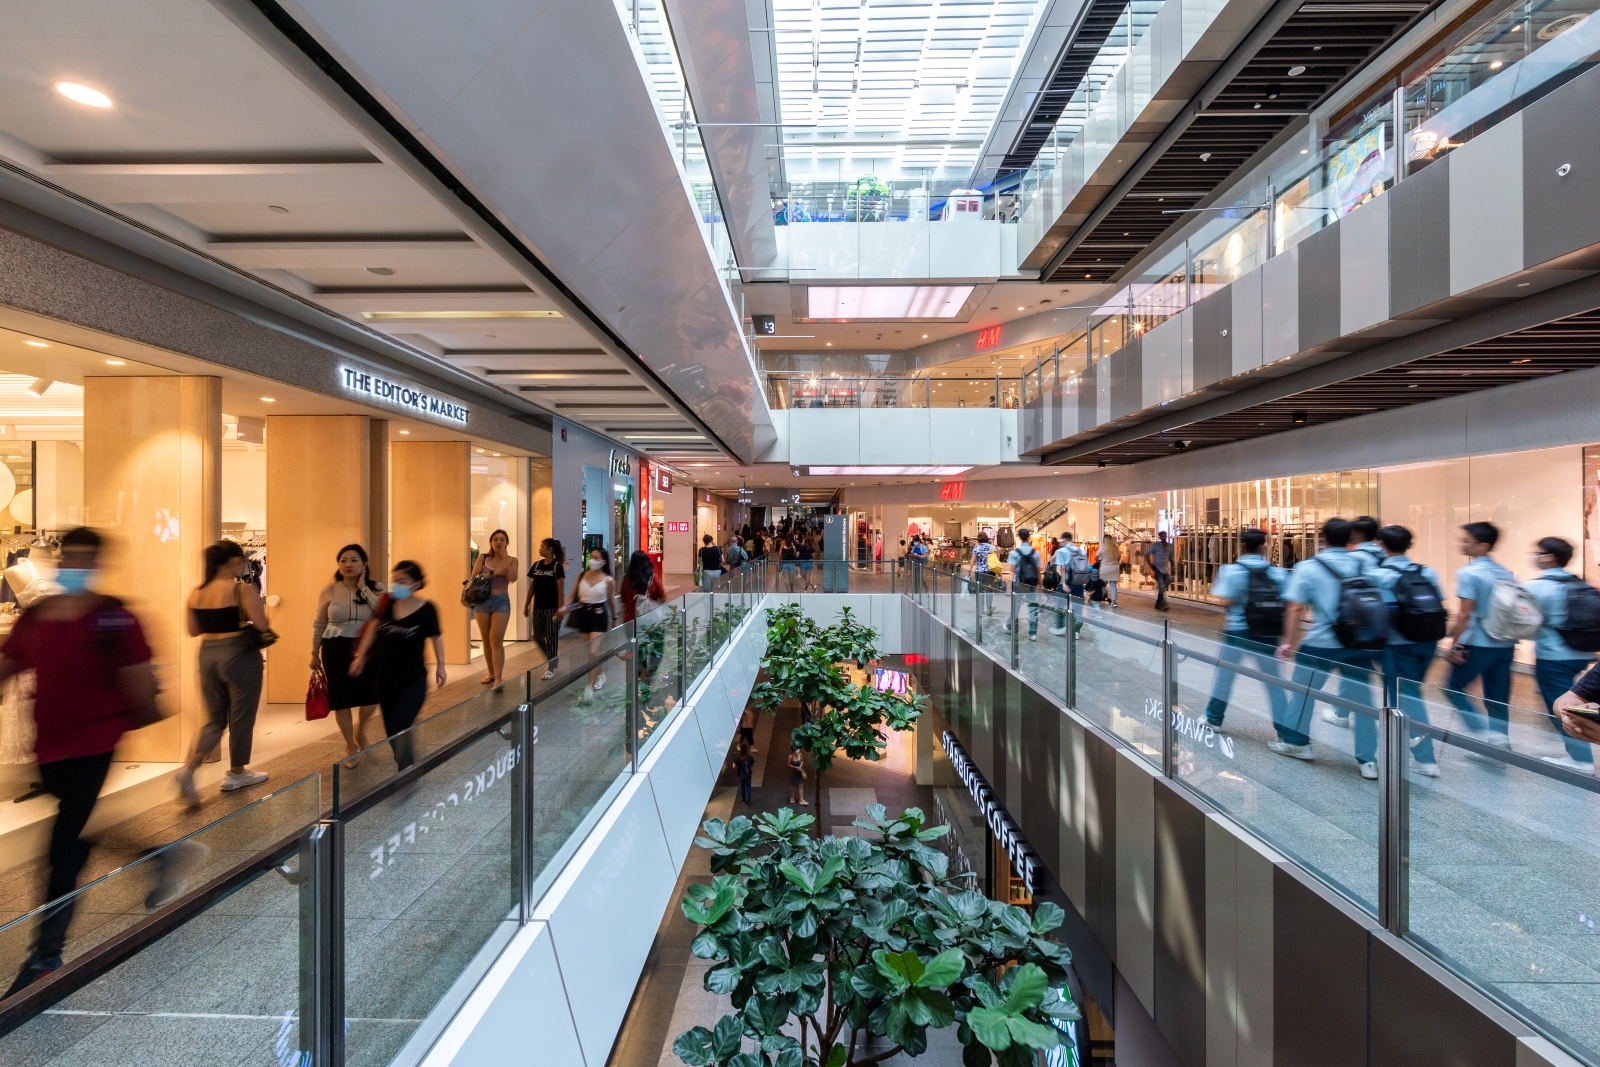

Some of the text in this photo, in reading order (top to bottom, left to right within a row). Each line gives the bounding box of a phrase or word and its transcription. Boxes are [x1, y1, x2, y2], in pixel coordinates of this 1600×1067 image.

[976, 326, 1001, 351] H&M
[344, 368, 470, 423] THE EDITOR'S MARKET
[609, 449, 631, 478] fresh
[940, 481, 964, 501] H&M
[942, 730, 987, 815] STARBUCKS
[987, 801, 1036, 896] COFFEE
